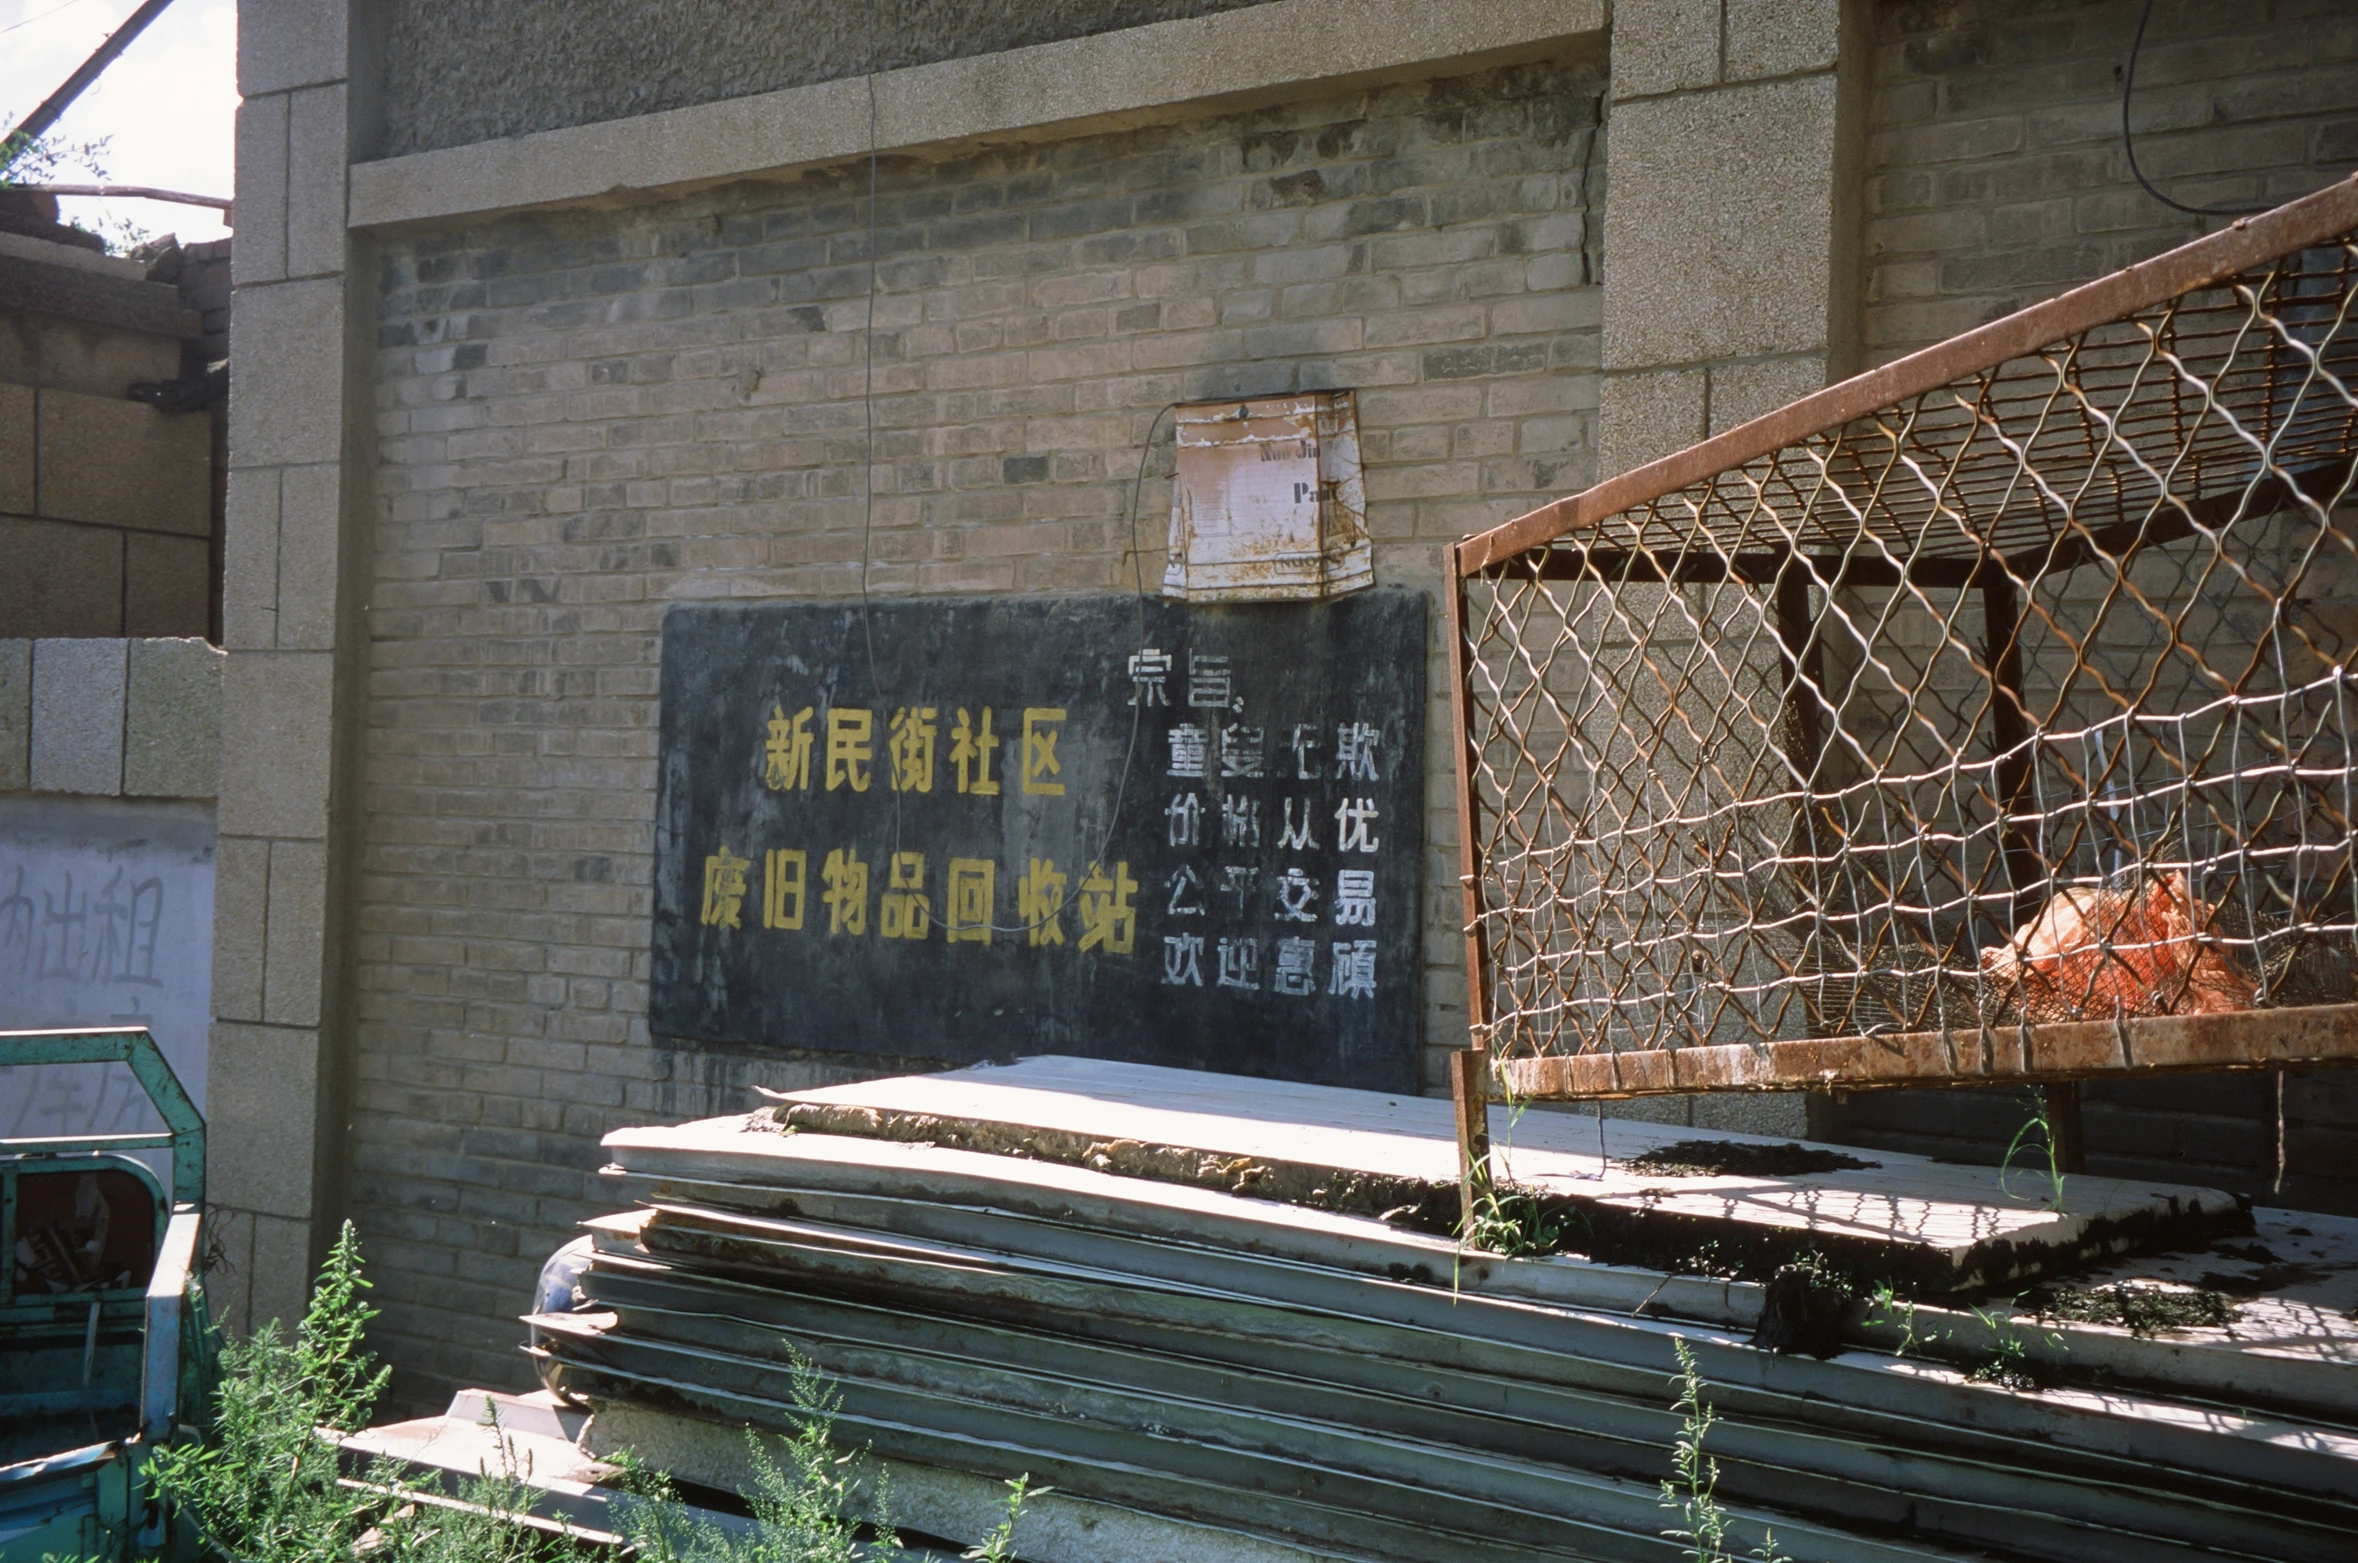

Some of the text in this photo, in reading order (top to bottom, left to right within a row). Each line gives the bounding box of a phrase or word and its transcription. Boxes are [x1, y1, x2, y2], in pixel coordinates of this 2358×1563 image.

[767, 706, 1067, 796] 新民街社区
[1167, 722, 1380, 781] 童叟无欺
[1164, 792, 1379, 852] 价格从优
[700, 846, 1139, 954] 废旧物品回收站
[1163, 864, 1377, 927] 公平交易
